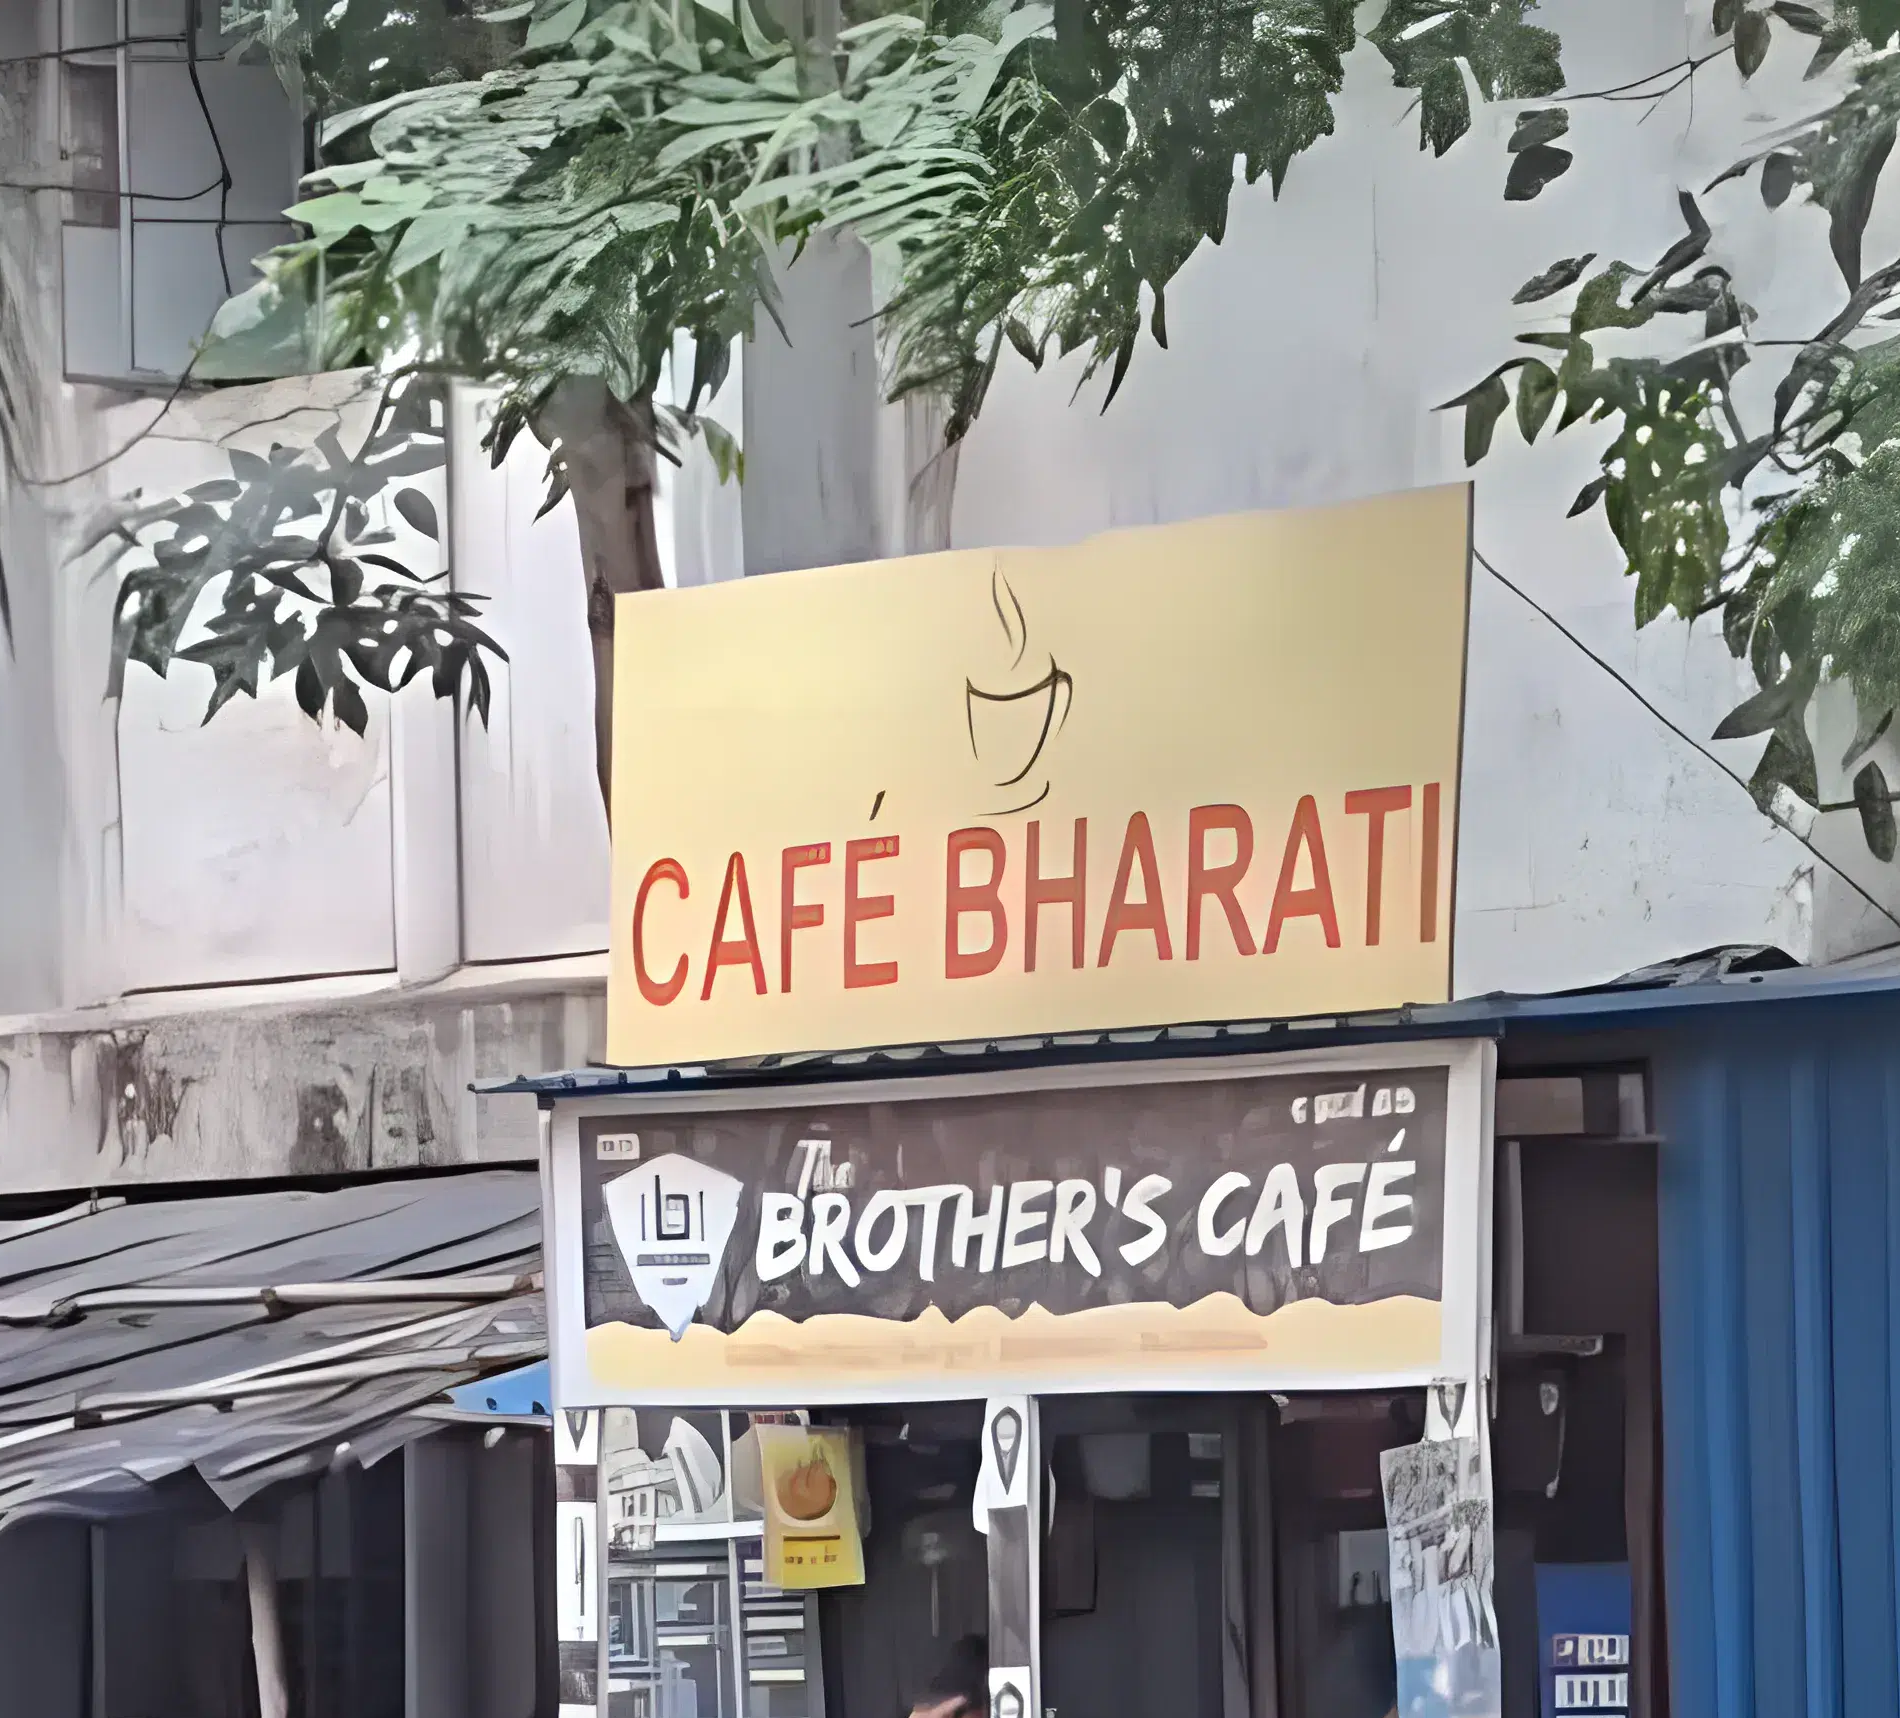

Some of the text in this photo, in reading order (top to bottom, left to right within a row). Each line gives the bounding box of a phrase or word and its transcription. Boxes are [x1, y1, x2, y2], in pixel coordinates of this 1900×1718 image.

[633, 782, 1439, 1005] CAFÉ BHARATI
[755, 1129, 1416, 1288] BROTHER'S CAFÉ
